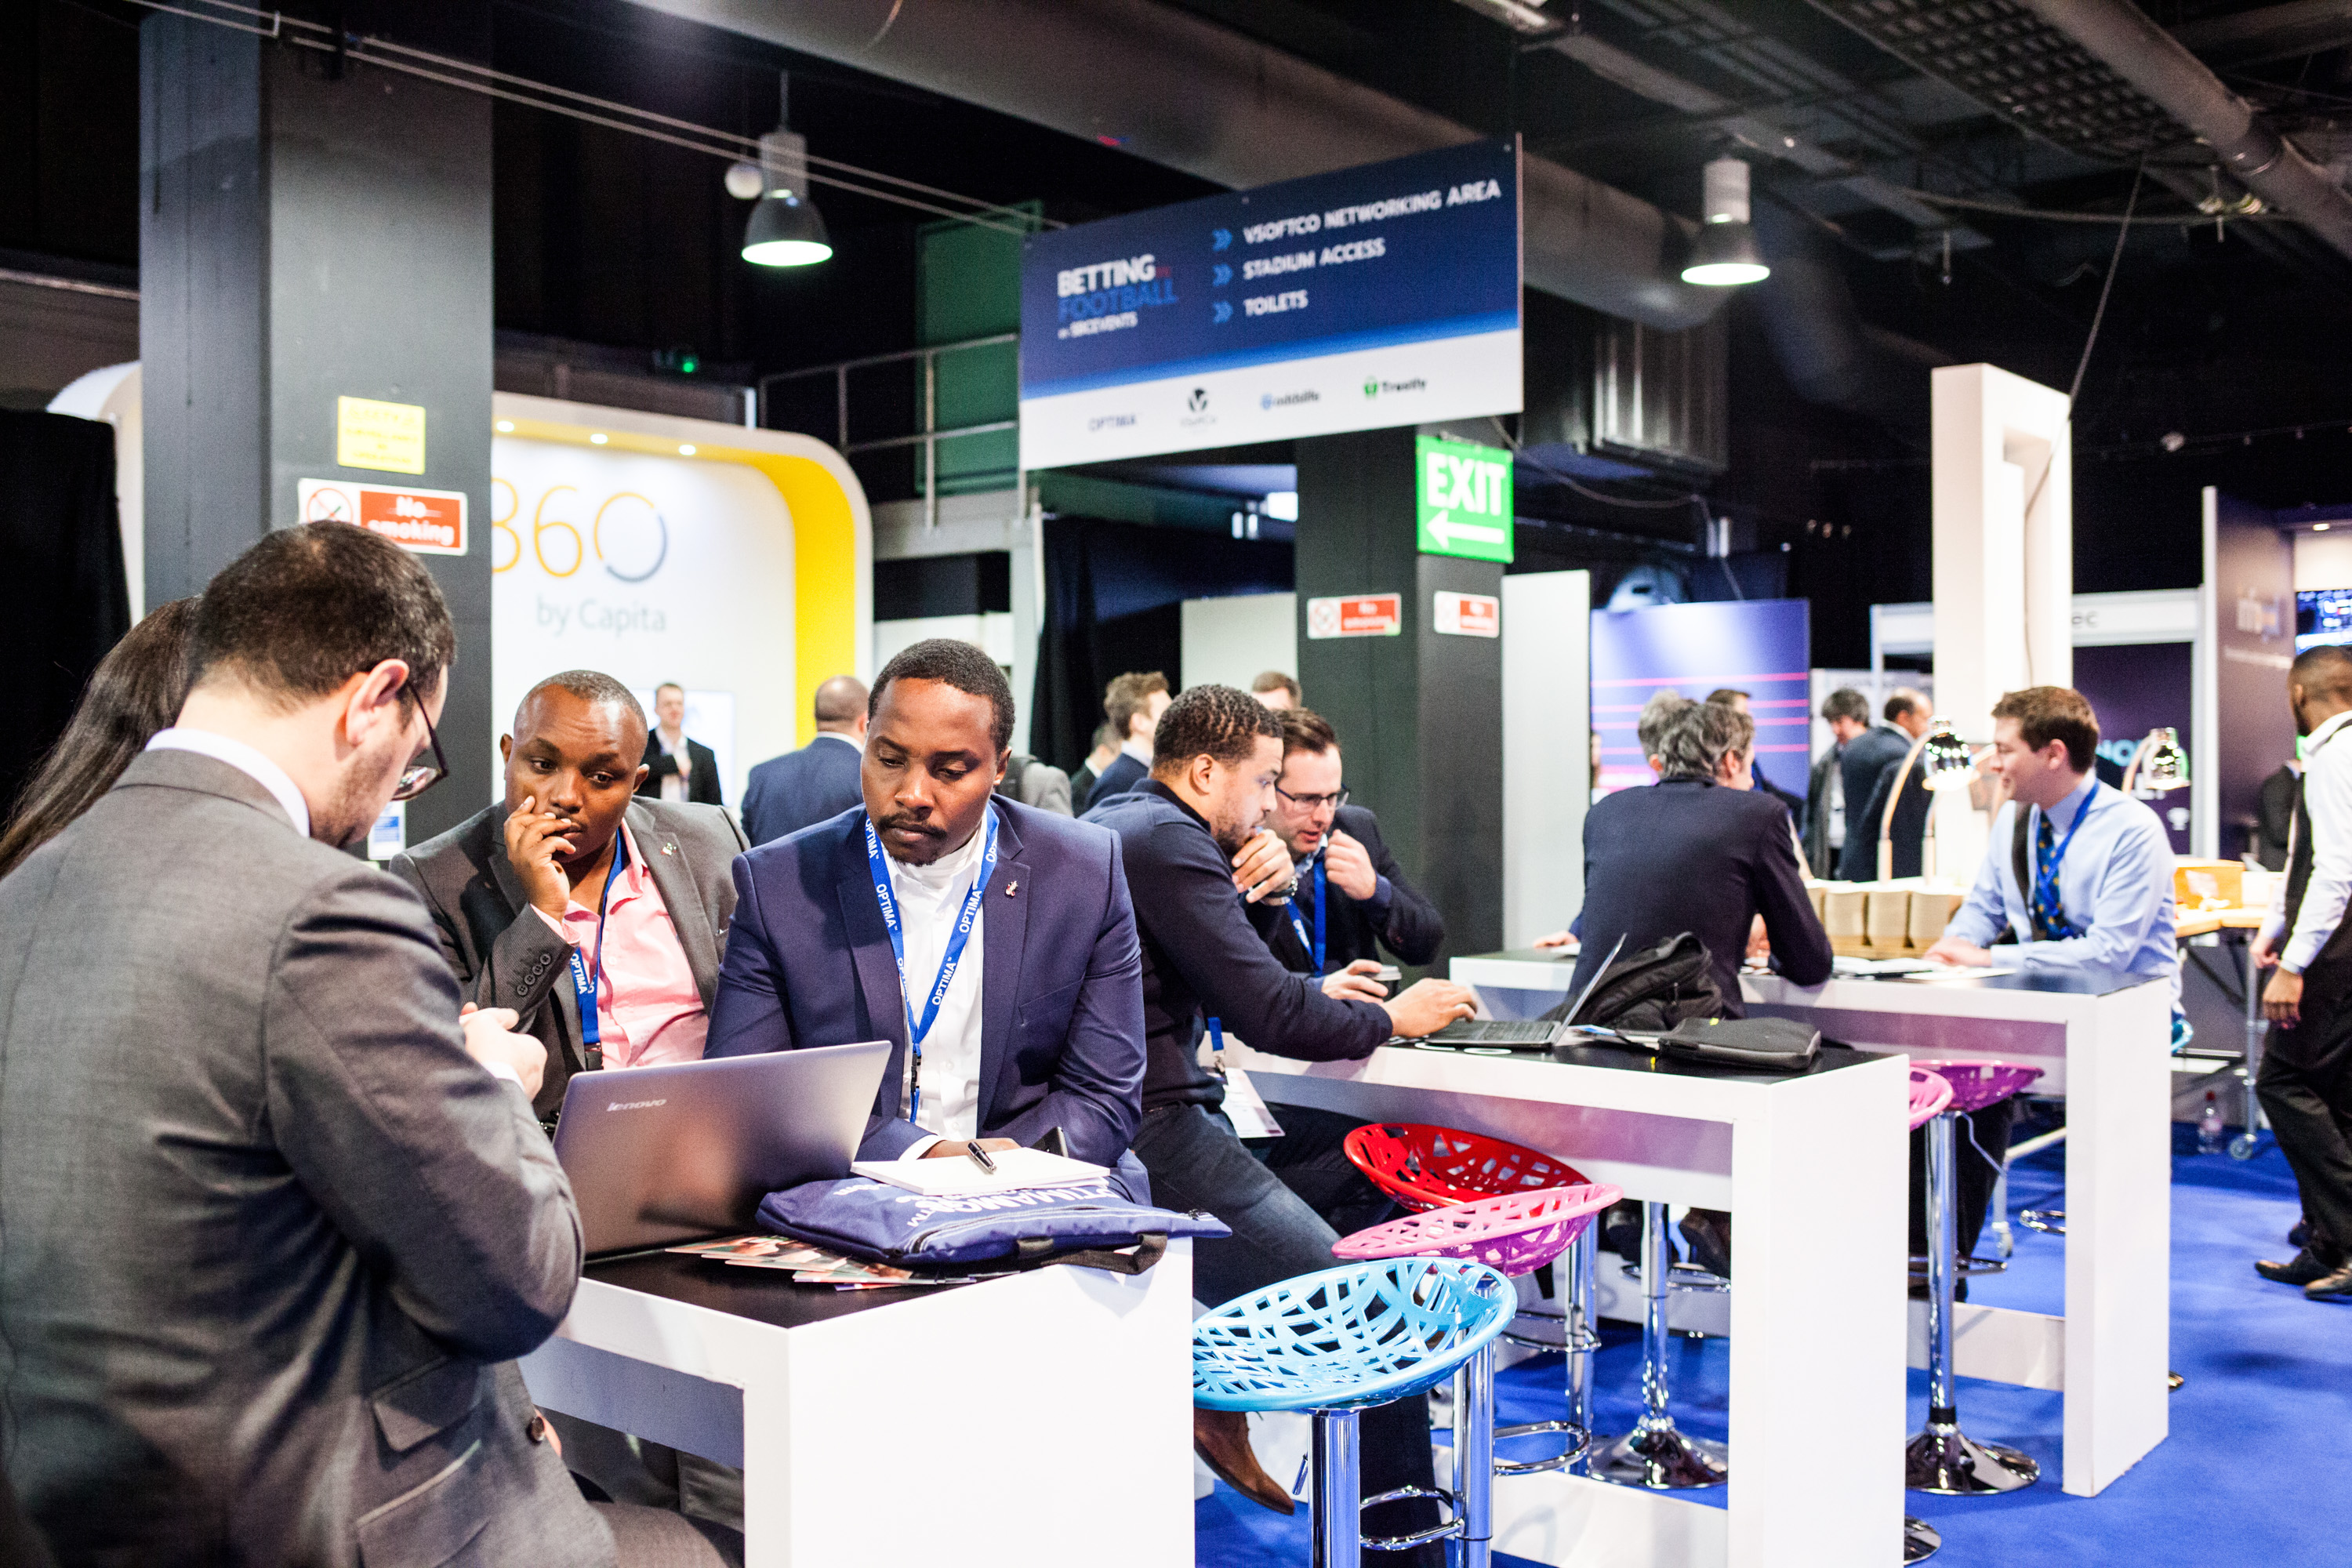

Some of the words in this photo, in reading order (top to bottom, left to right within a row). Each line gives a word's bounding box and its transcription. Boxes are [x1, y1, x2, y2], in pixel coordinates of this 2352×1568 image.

[1243, 213, 1321, 244] VSOFTCO
[1324, 190, 1442, 229] NETWORKING
[1446, 179, 1501, 206] AREA
[1057, 253, 1156, 297] BETTING
[1243, 250, 1316, 280] STADIUM
[1319, 237, 1385, 266] ACCESS
[1243, 289, 1308, 316] TOILETS
[1426, 451, 1507, 516] EXIT
[396, 495, 426, 518] No
[536, 593, 570, 638] by
[579, 597, 666, 638] Capita
[570, 953, 588, 994] OPTIMA
[606, 1098, 666, 1112] lenovo
